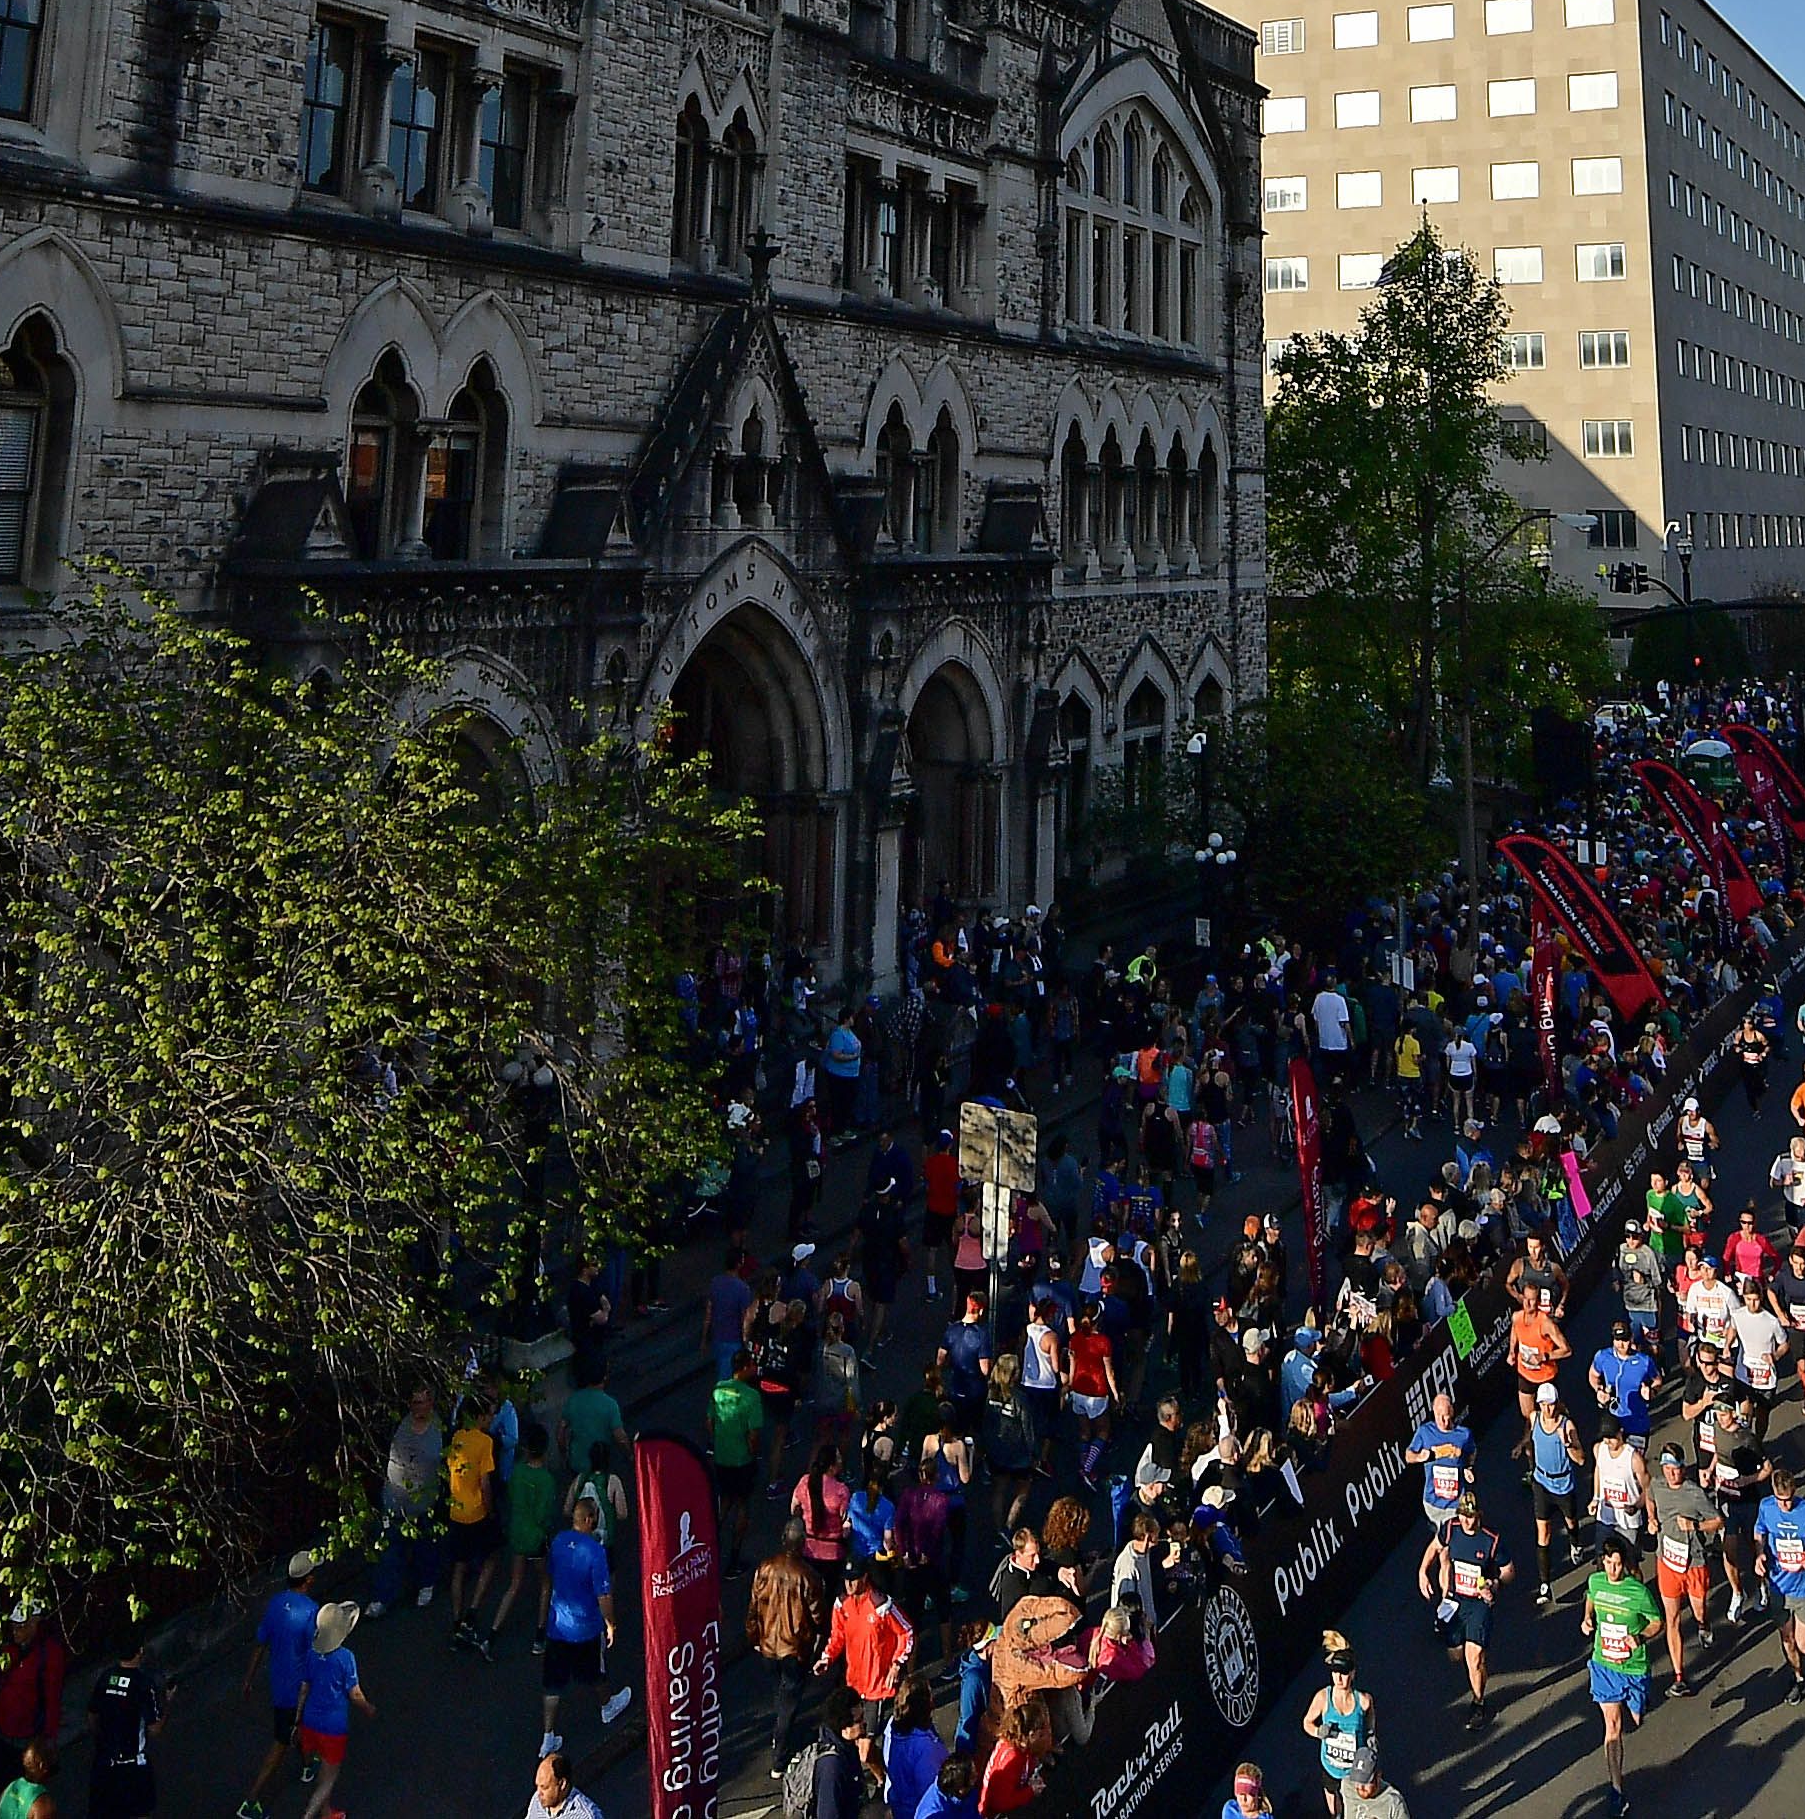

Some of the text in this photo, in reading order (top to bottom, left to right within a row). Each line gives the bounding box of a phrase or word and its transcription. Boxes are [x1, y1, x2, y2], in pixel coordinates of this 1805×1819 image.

[1536, 870, 1602, 955] MARATHON SERIES
[664, 1645, 695, 1792] Saving
[1225, 1666, 1258, 1725] TOURS
[1091, 1759, 1140, 1819] Rock
[1145, 1701, 1183, 1758] Roll
[1154, 1732, 1184, 1777] SERIES
